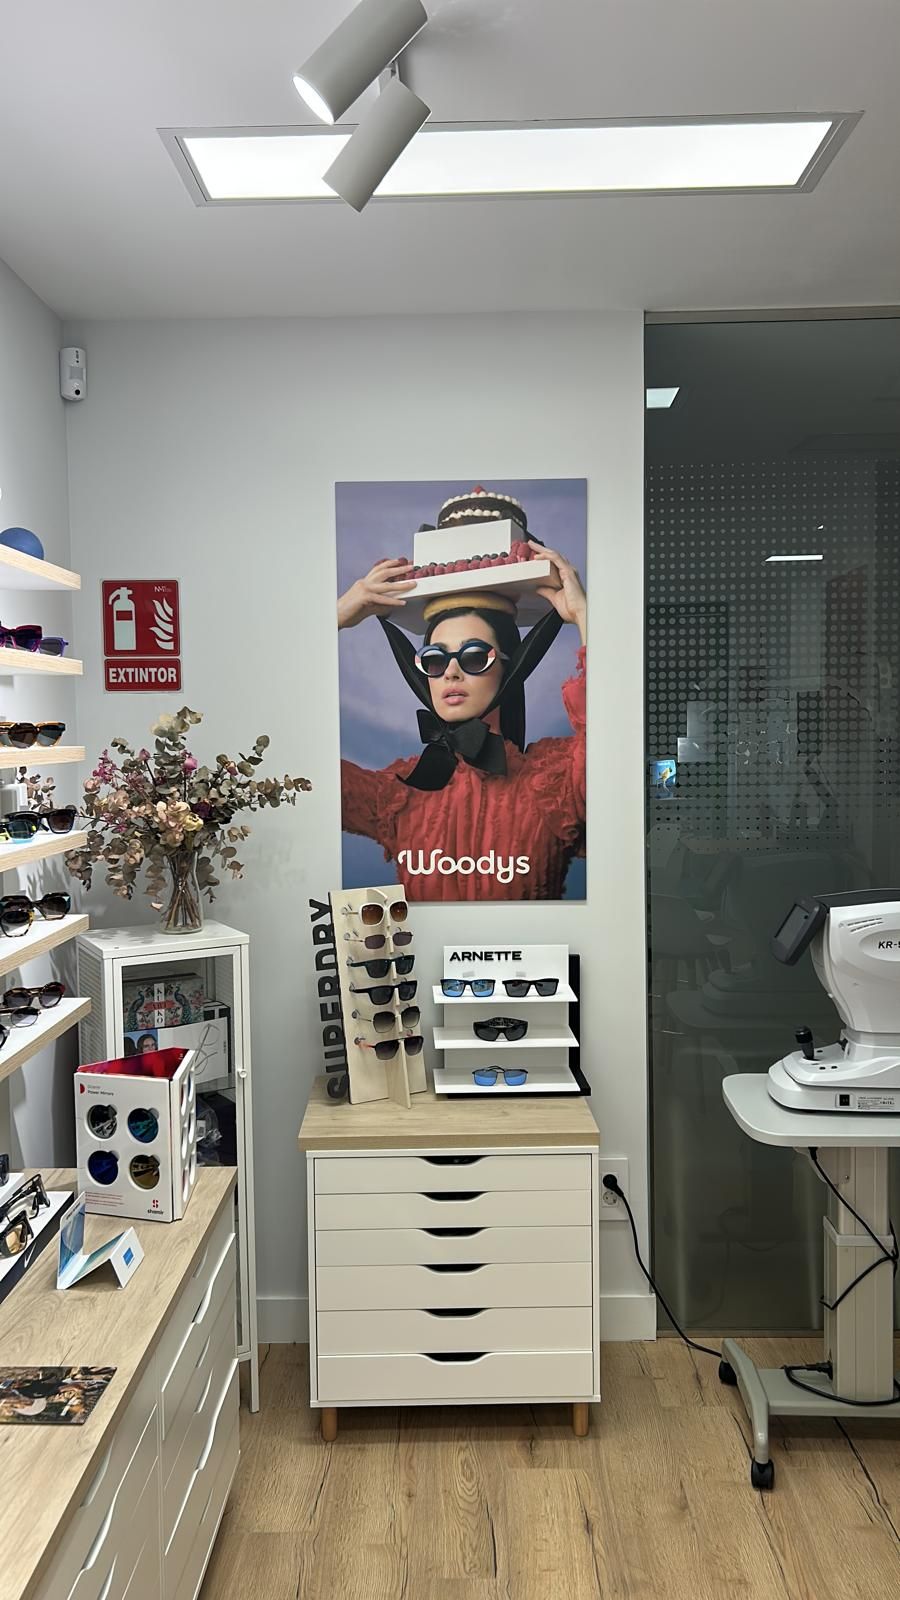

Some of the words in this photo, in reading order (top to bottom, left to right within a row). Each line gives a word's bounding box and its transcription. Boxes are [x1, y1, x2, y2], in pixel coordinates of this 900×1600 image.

[108, 667, 177, 683] EXTINTOR
[397, 848, 531, 884] Woodys
[449, 950, 522, 961] ARNETTE
